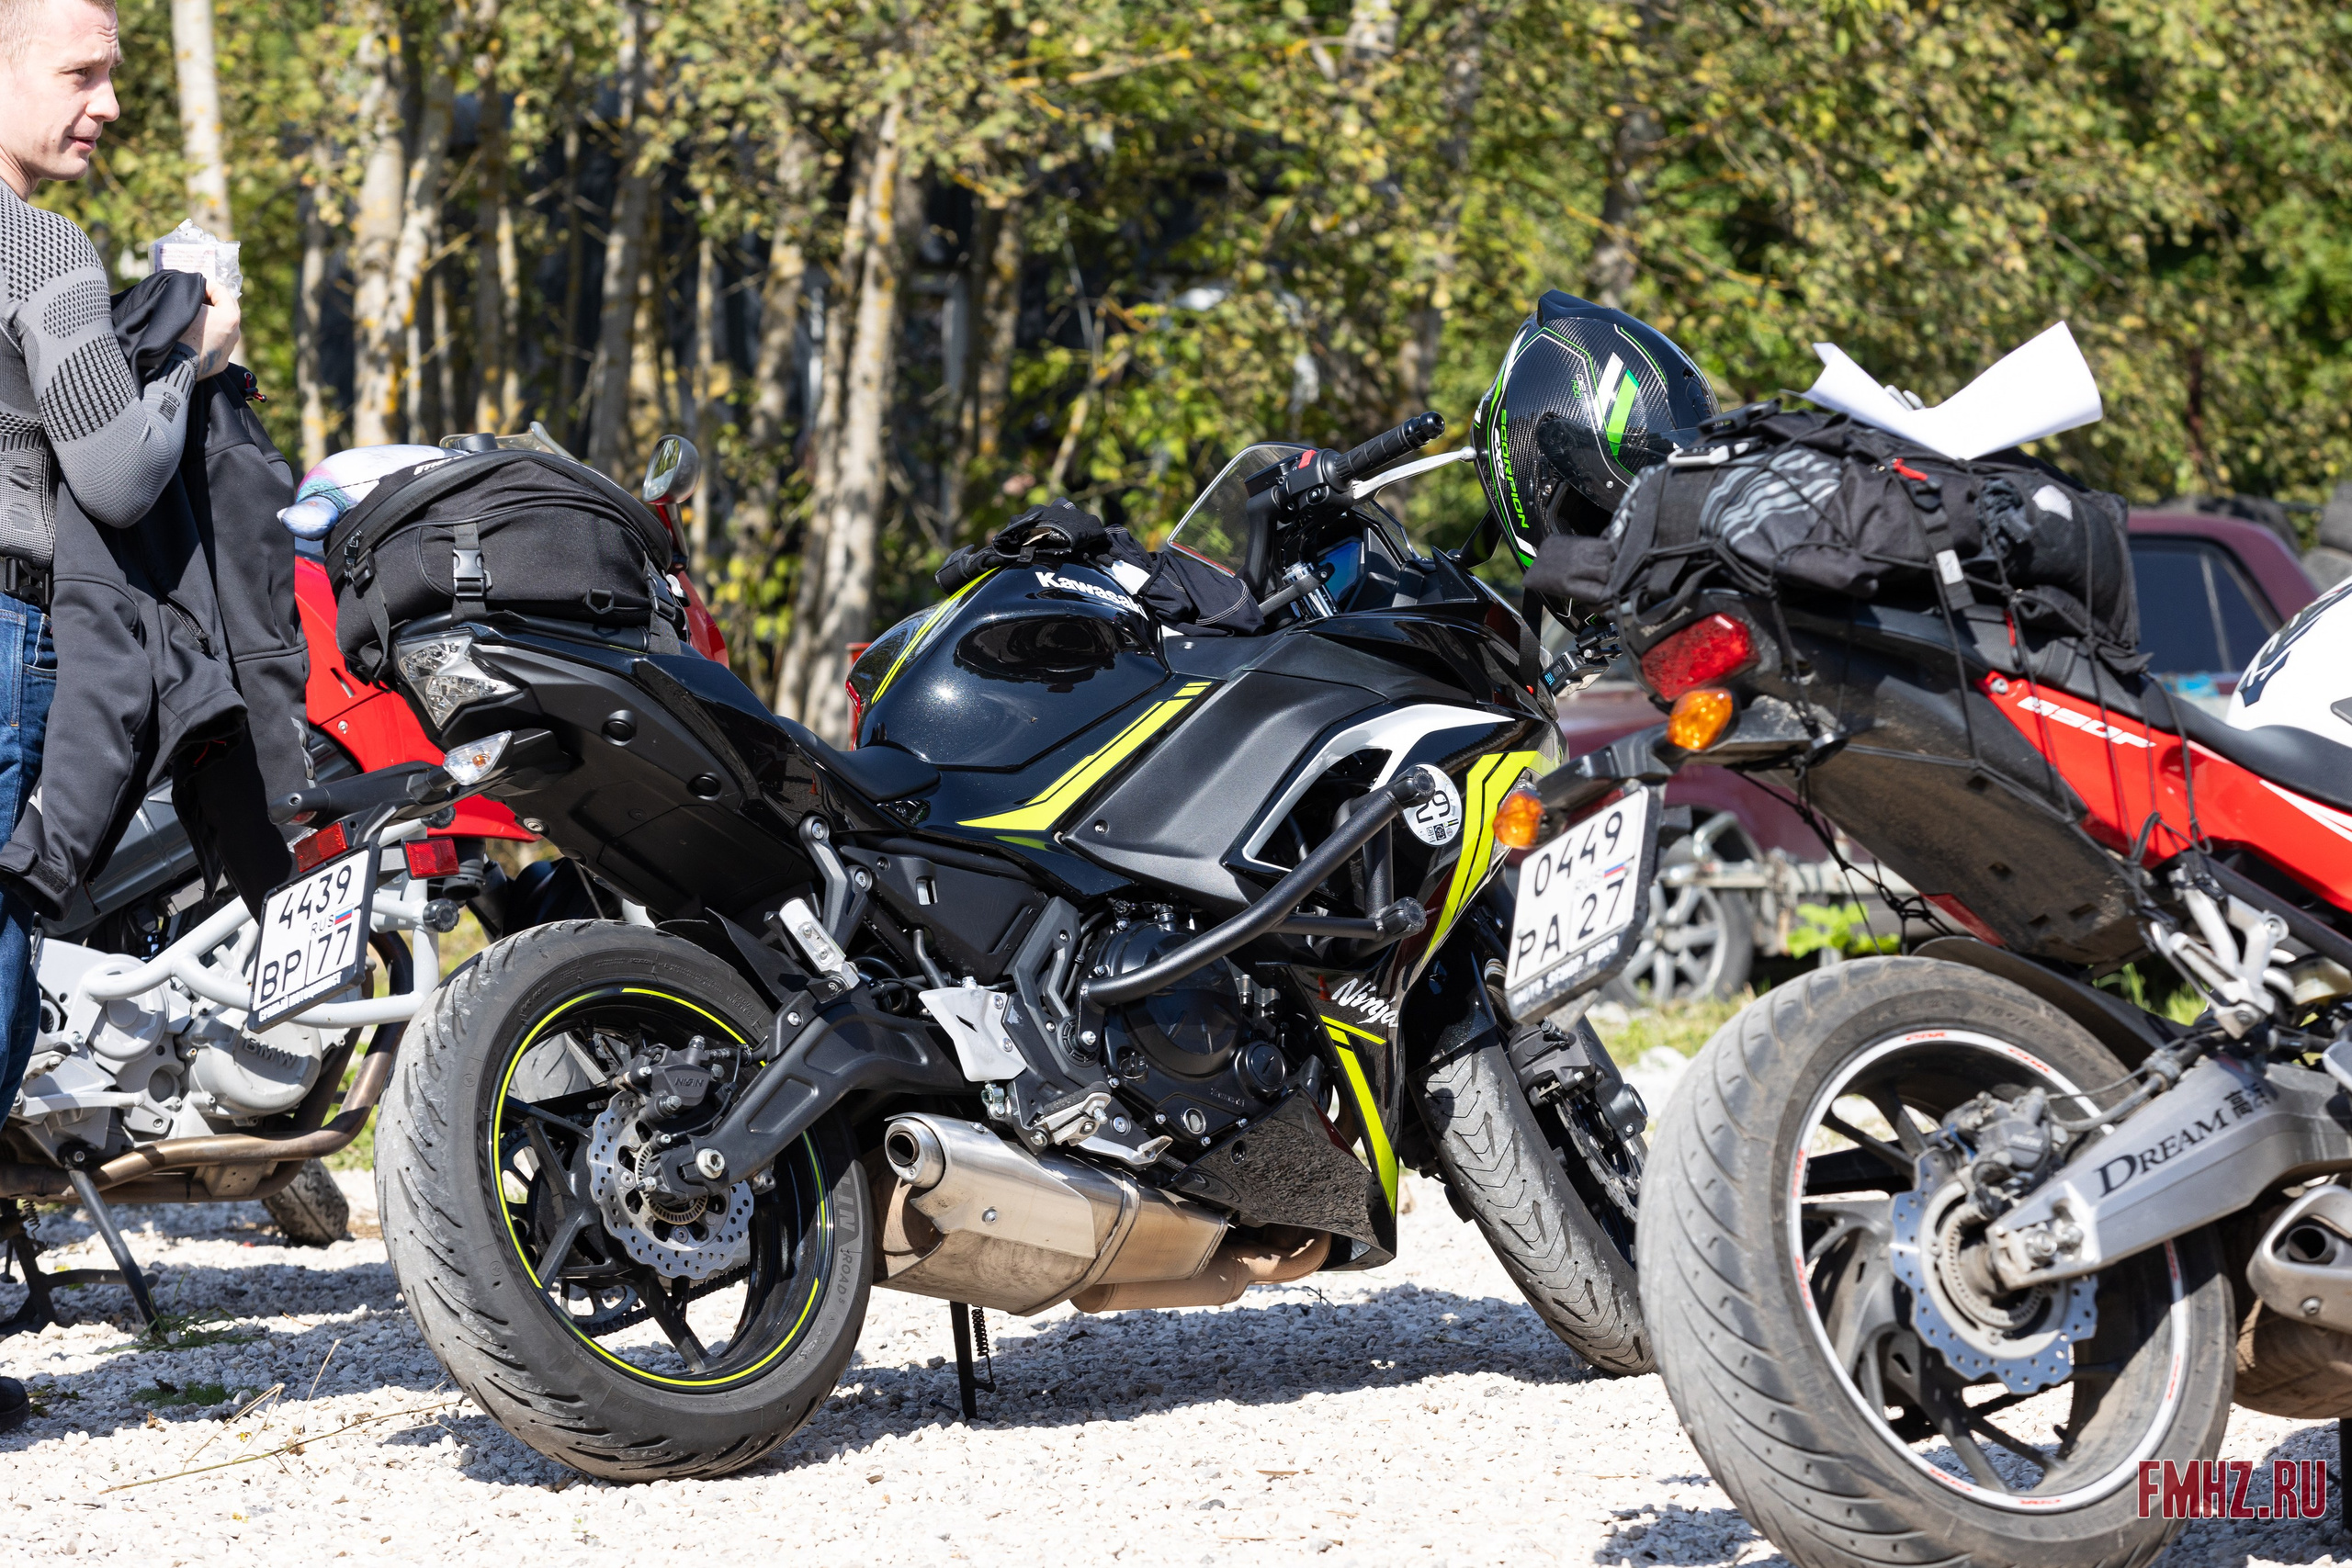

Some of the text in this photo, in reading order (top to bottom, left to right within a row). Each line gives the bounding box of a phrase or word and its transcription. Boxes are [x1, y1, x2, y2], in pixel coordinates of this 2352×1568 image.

[1500, 409, 1530, 528] SCORPION
[1416, 790, 1451, 824] 29
[1533, 810, 1623, 897] 0449
[278, 864, 352, 930] 4439
[1577, 878, 1623, 941] 27
[311, 914, 334, 936] RUS
[317, 922, 352, 976] 77
[733, 993, 755, 1011] RADIAL
[1330, 978, 1399, 1028] Ninja
[243, 1036, 299, 1068] BMW
[2093, 1109, 2230, 1198] DREAM
[478, 1130, 537, 1308] MICHELIN
[836, 1252, 853, 1295] ROAD
